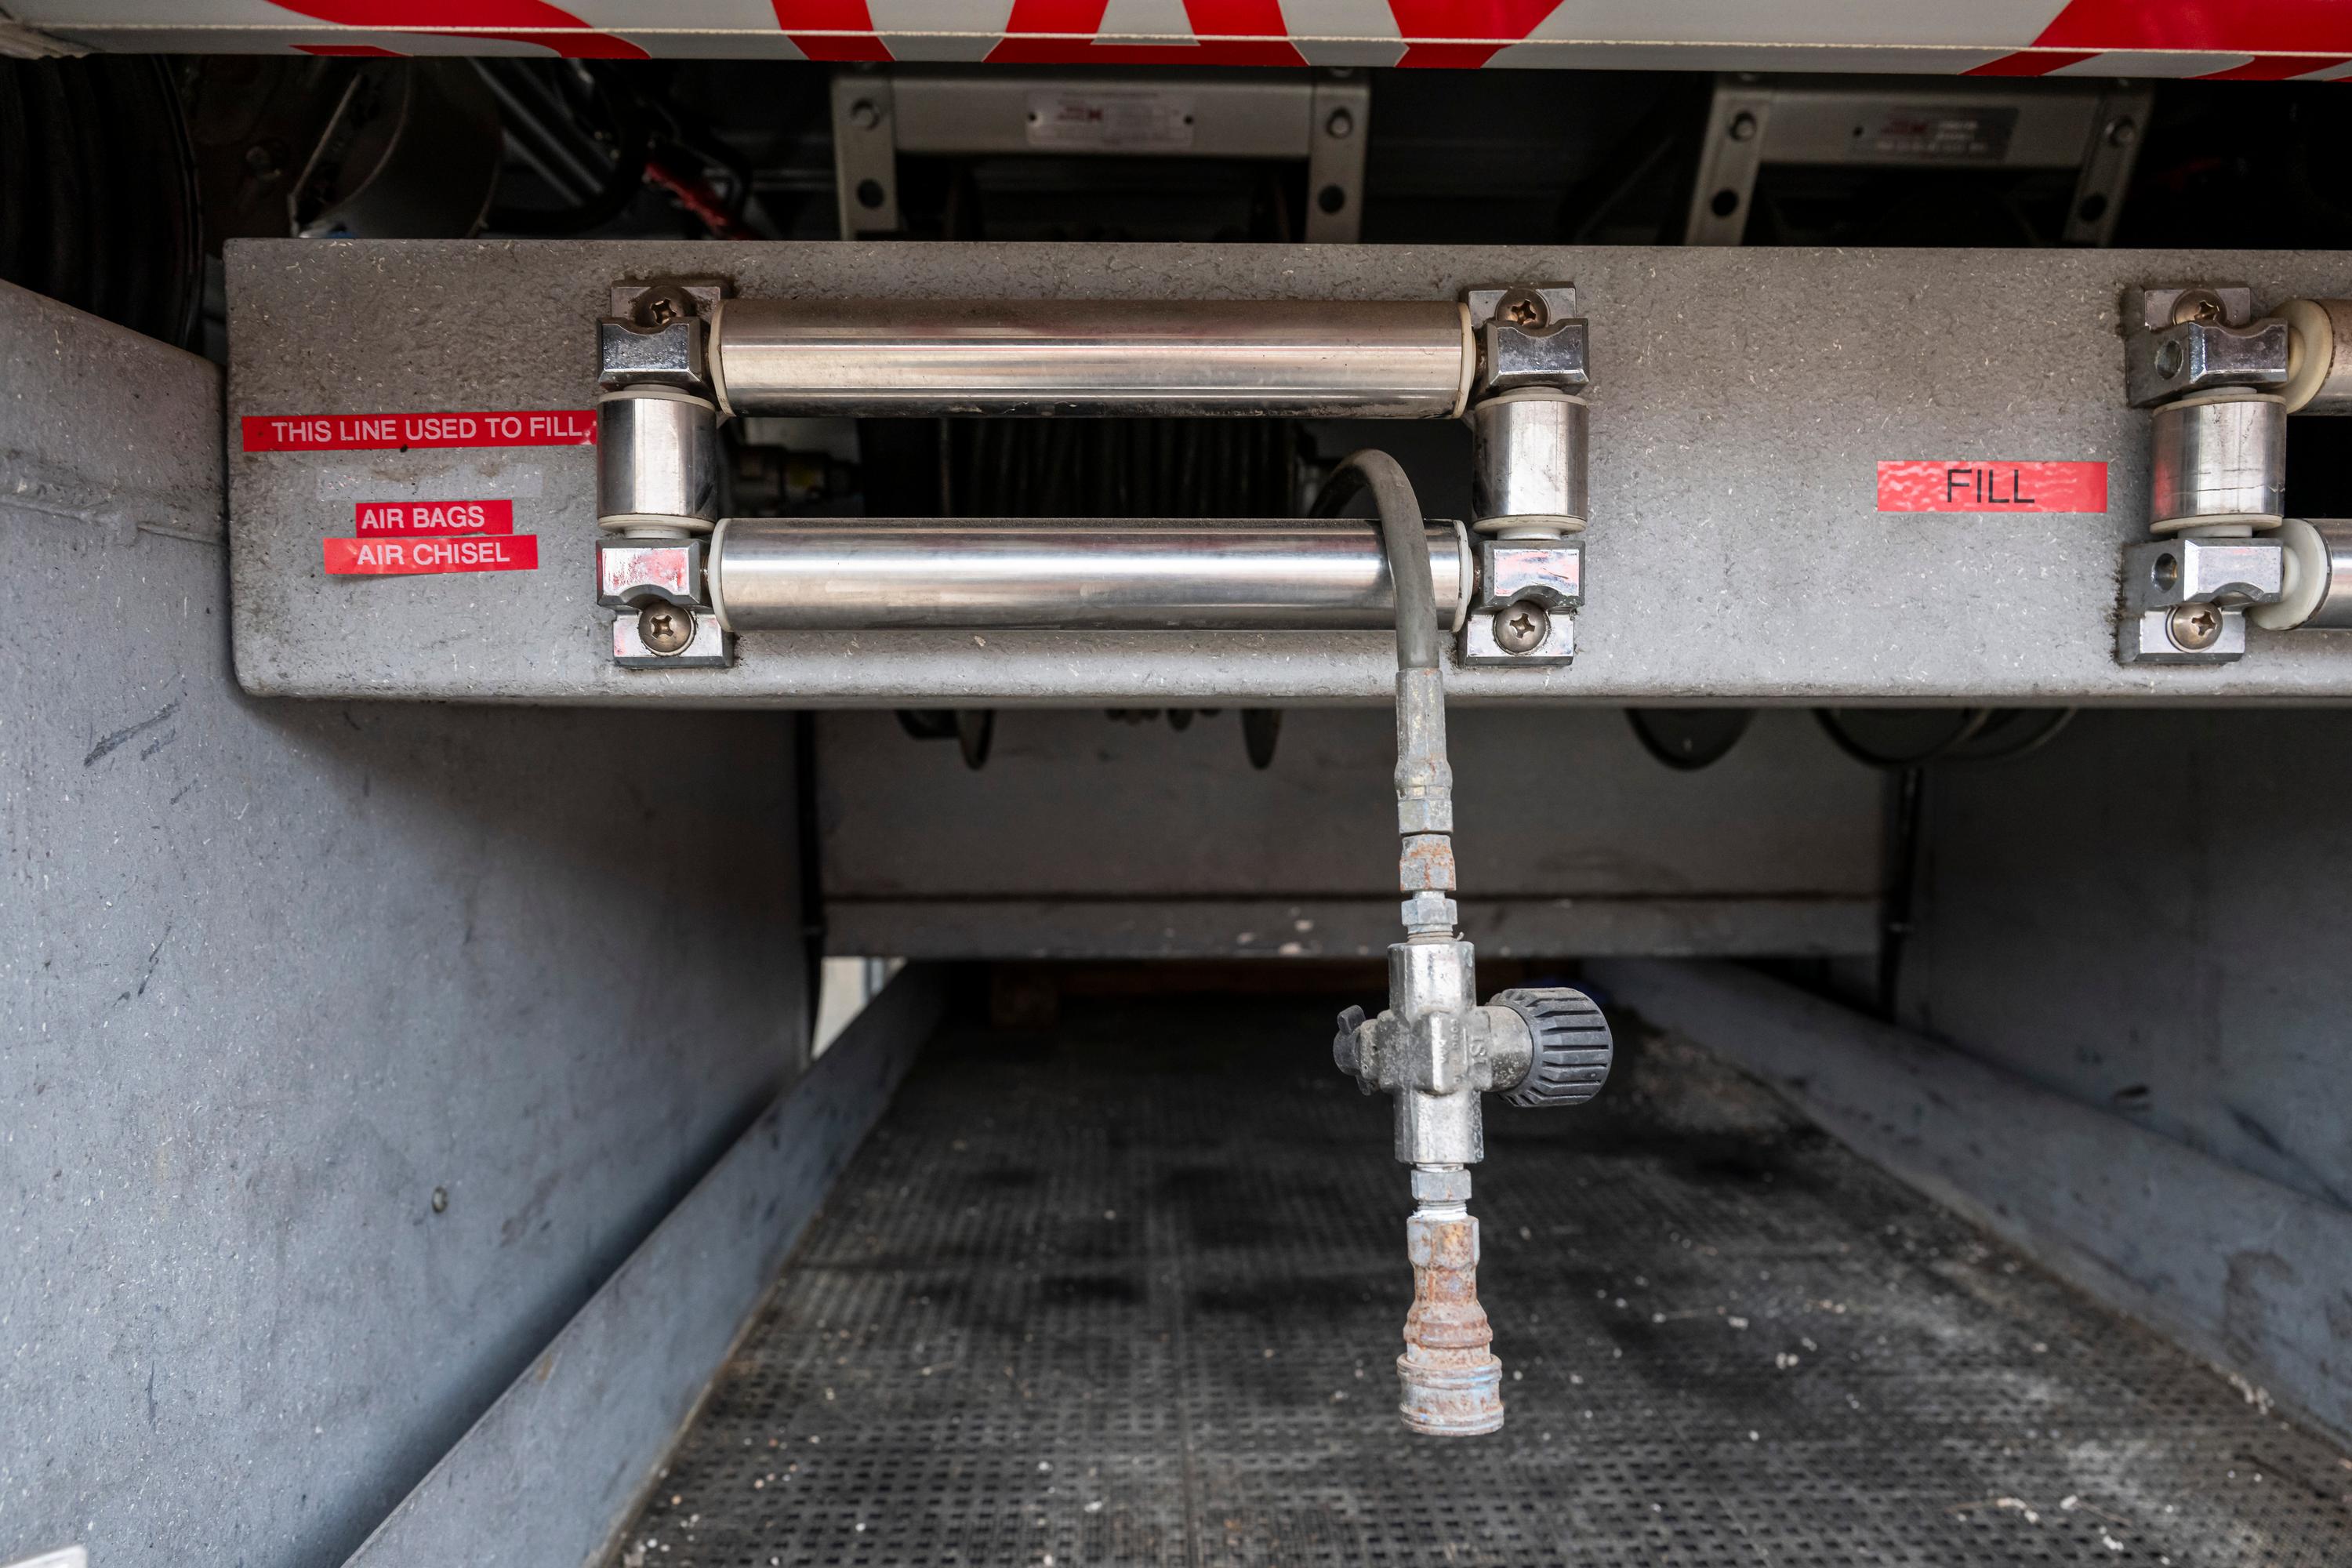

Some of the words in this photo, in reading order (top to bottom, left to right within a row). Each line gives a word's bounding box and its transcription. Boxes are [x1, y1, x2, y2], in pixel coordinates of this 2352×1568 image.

[272, 420, 332, 442] THIS
[340, 419, 397, 441] LINE
[405, 418, 477, 441] USED
[485, 416, 522, 438] TO
[530, 416, 583, 437] FILL
[1947, 469, 2034, 503] FILL
[361, 508, 405, 529] AIR
[412, 506, 485, 528] BAGS
[357, 544, 405, 565] AIR
[412, 542, 510, 564] CHISEL
